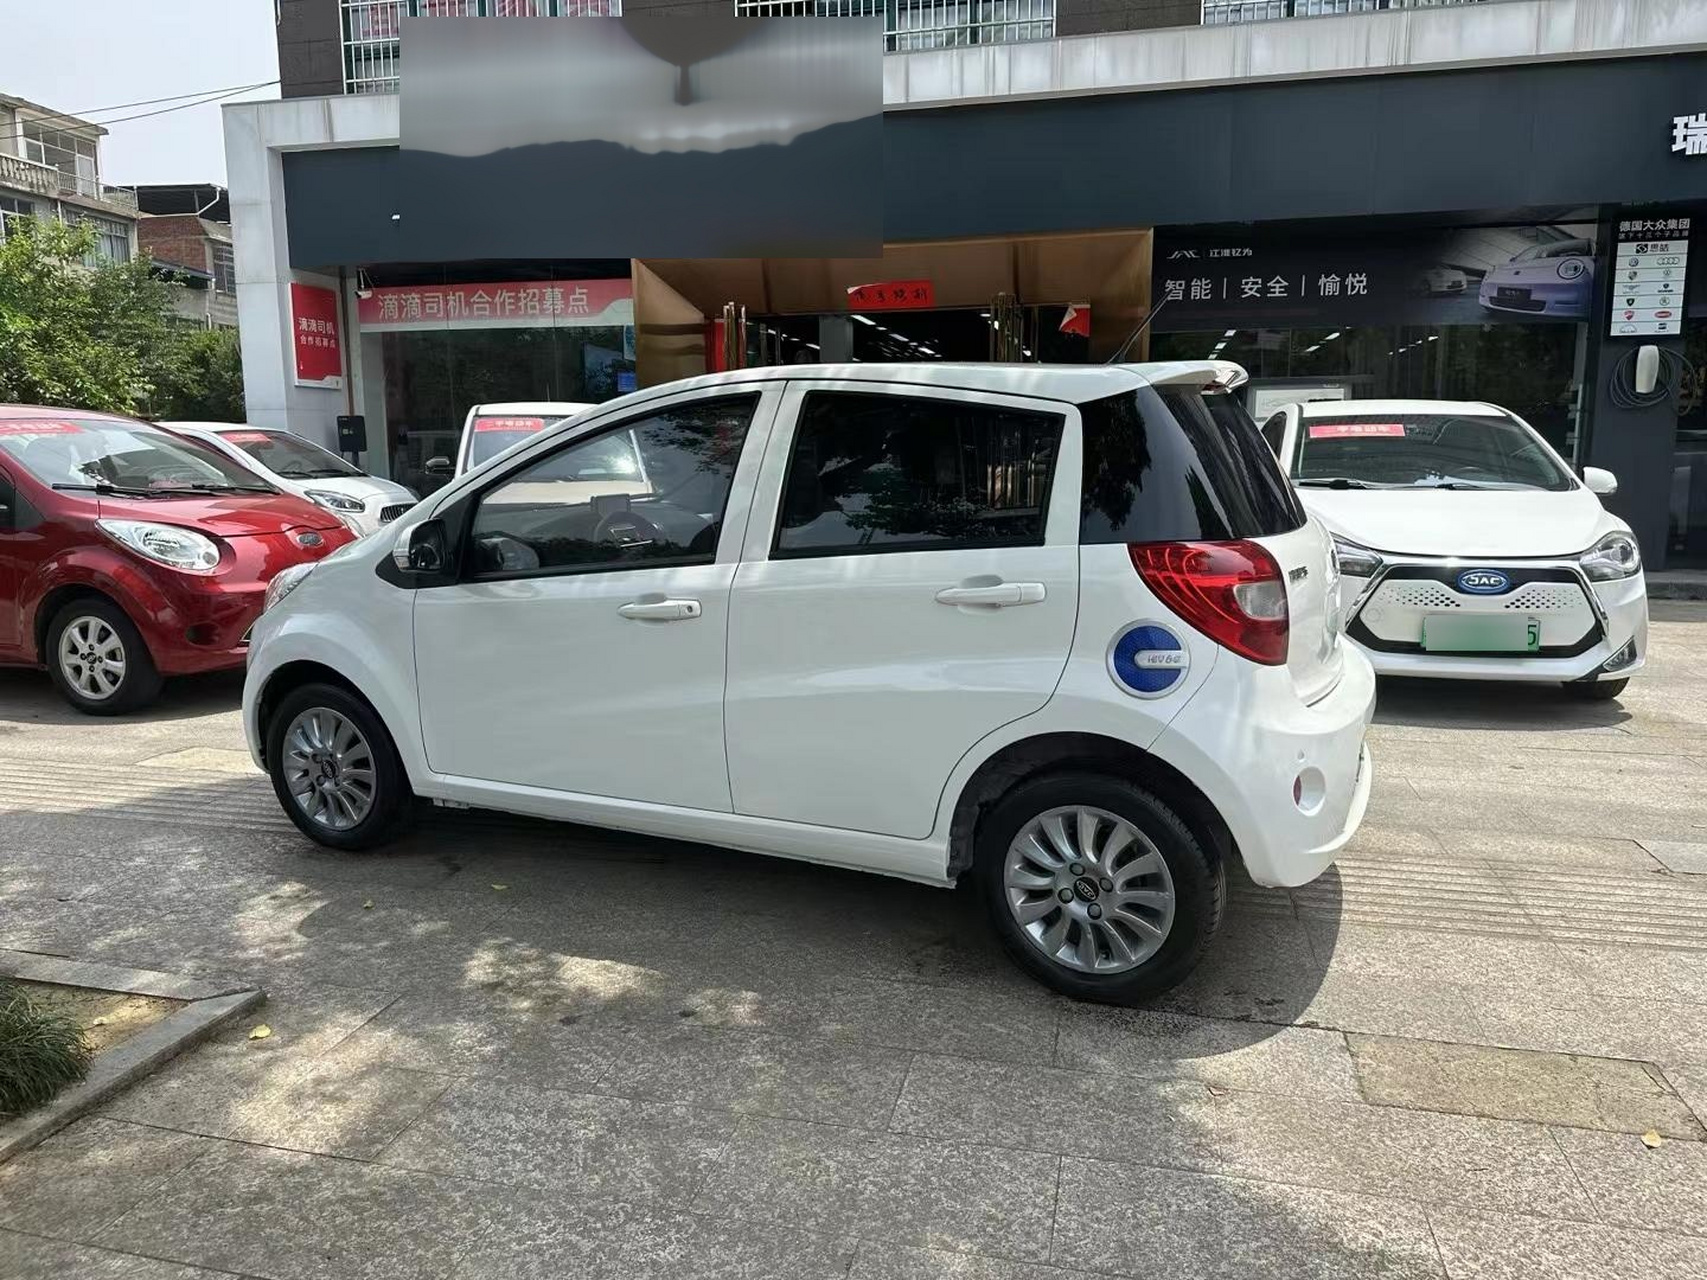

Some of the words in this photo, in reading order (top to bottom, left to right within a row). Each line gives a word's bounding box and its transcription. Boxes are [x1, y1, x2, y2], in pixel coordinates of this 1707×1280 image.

[1619, 218, 1690, 231] 德国大众集团
[1165, 278, 1212, 300] 智能
[1241, 275, 1290, 298] 安全
[1318, 273, 1368, 296] 愉悦
[378, 288, 589, 320] 滴滴司机合作招募点
[298, 317, 335, 335] 滴滴司机
[1468, 576, 1500, 585] JAC
